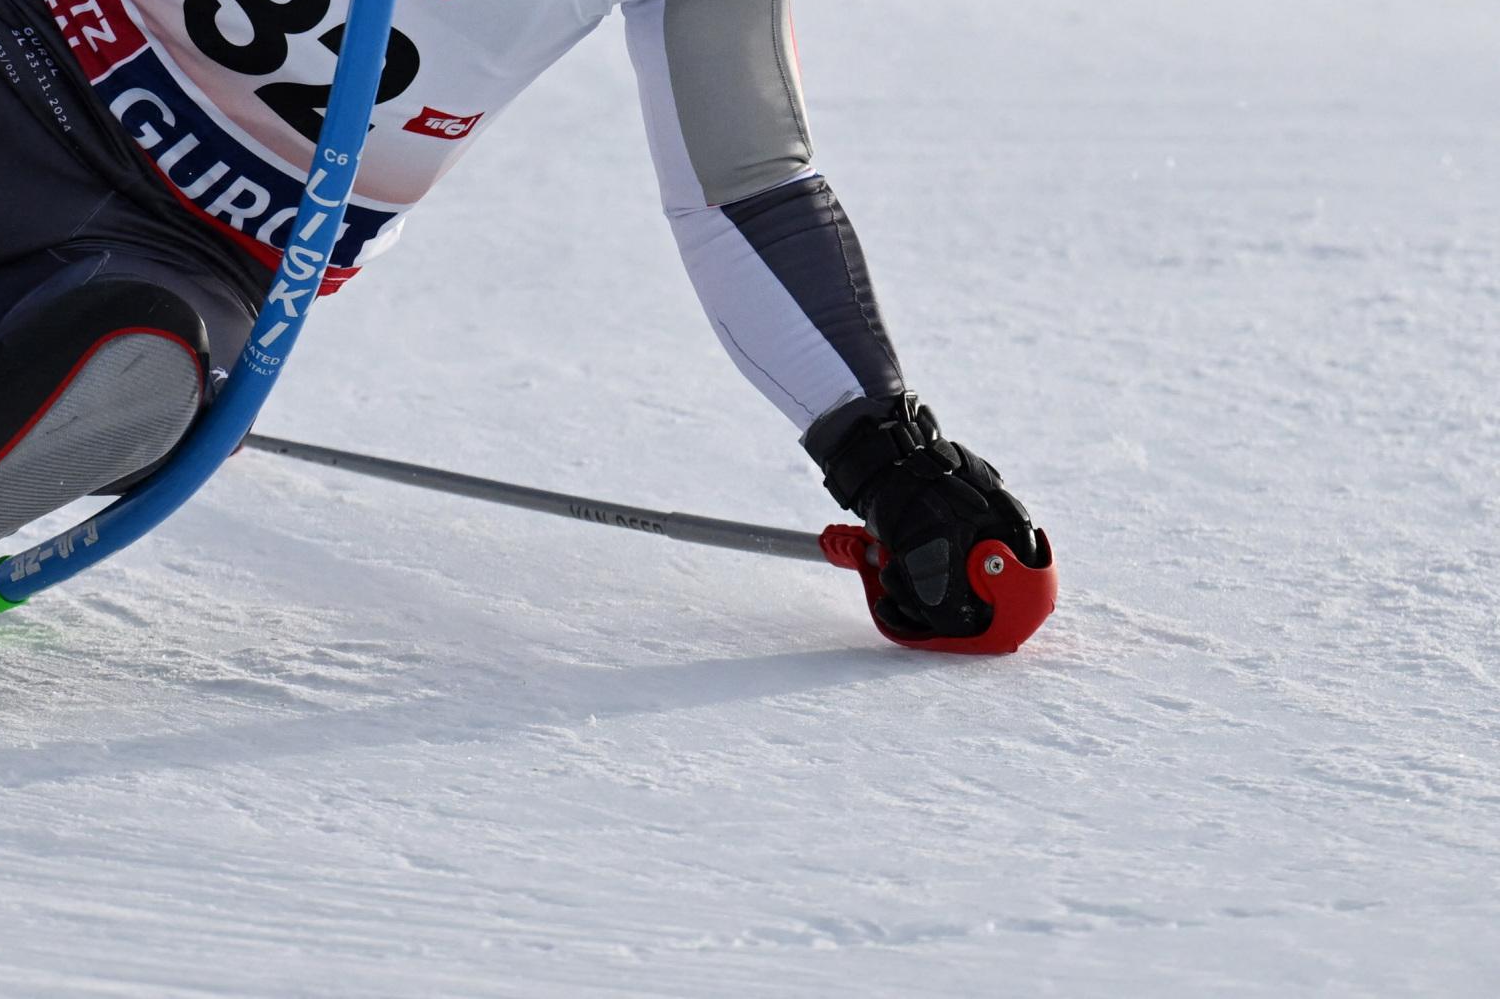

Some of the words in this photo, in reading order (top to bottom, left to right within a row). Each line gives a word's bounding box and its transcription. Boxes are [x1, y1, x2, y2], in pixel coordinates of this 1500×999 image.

[25, 52, 72, 132] 23.11.2024
[323, 147, 349, 166] C6
[258, 168, 341, 348] LISKI
